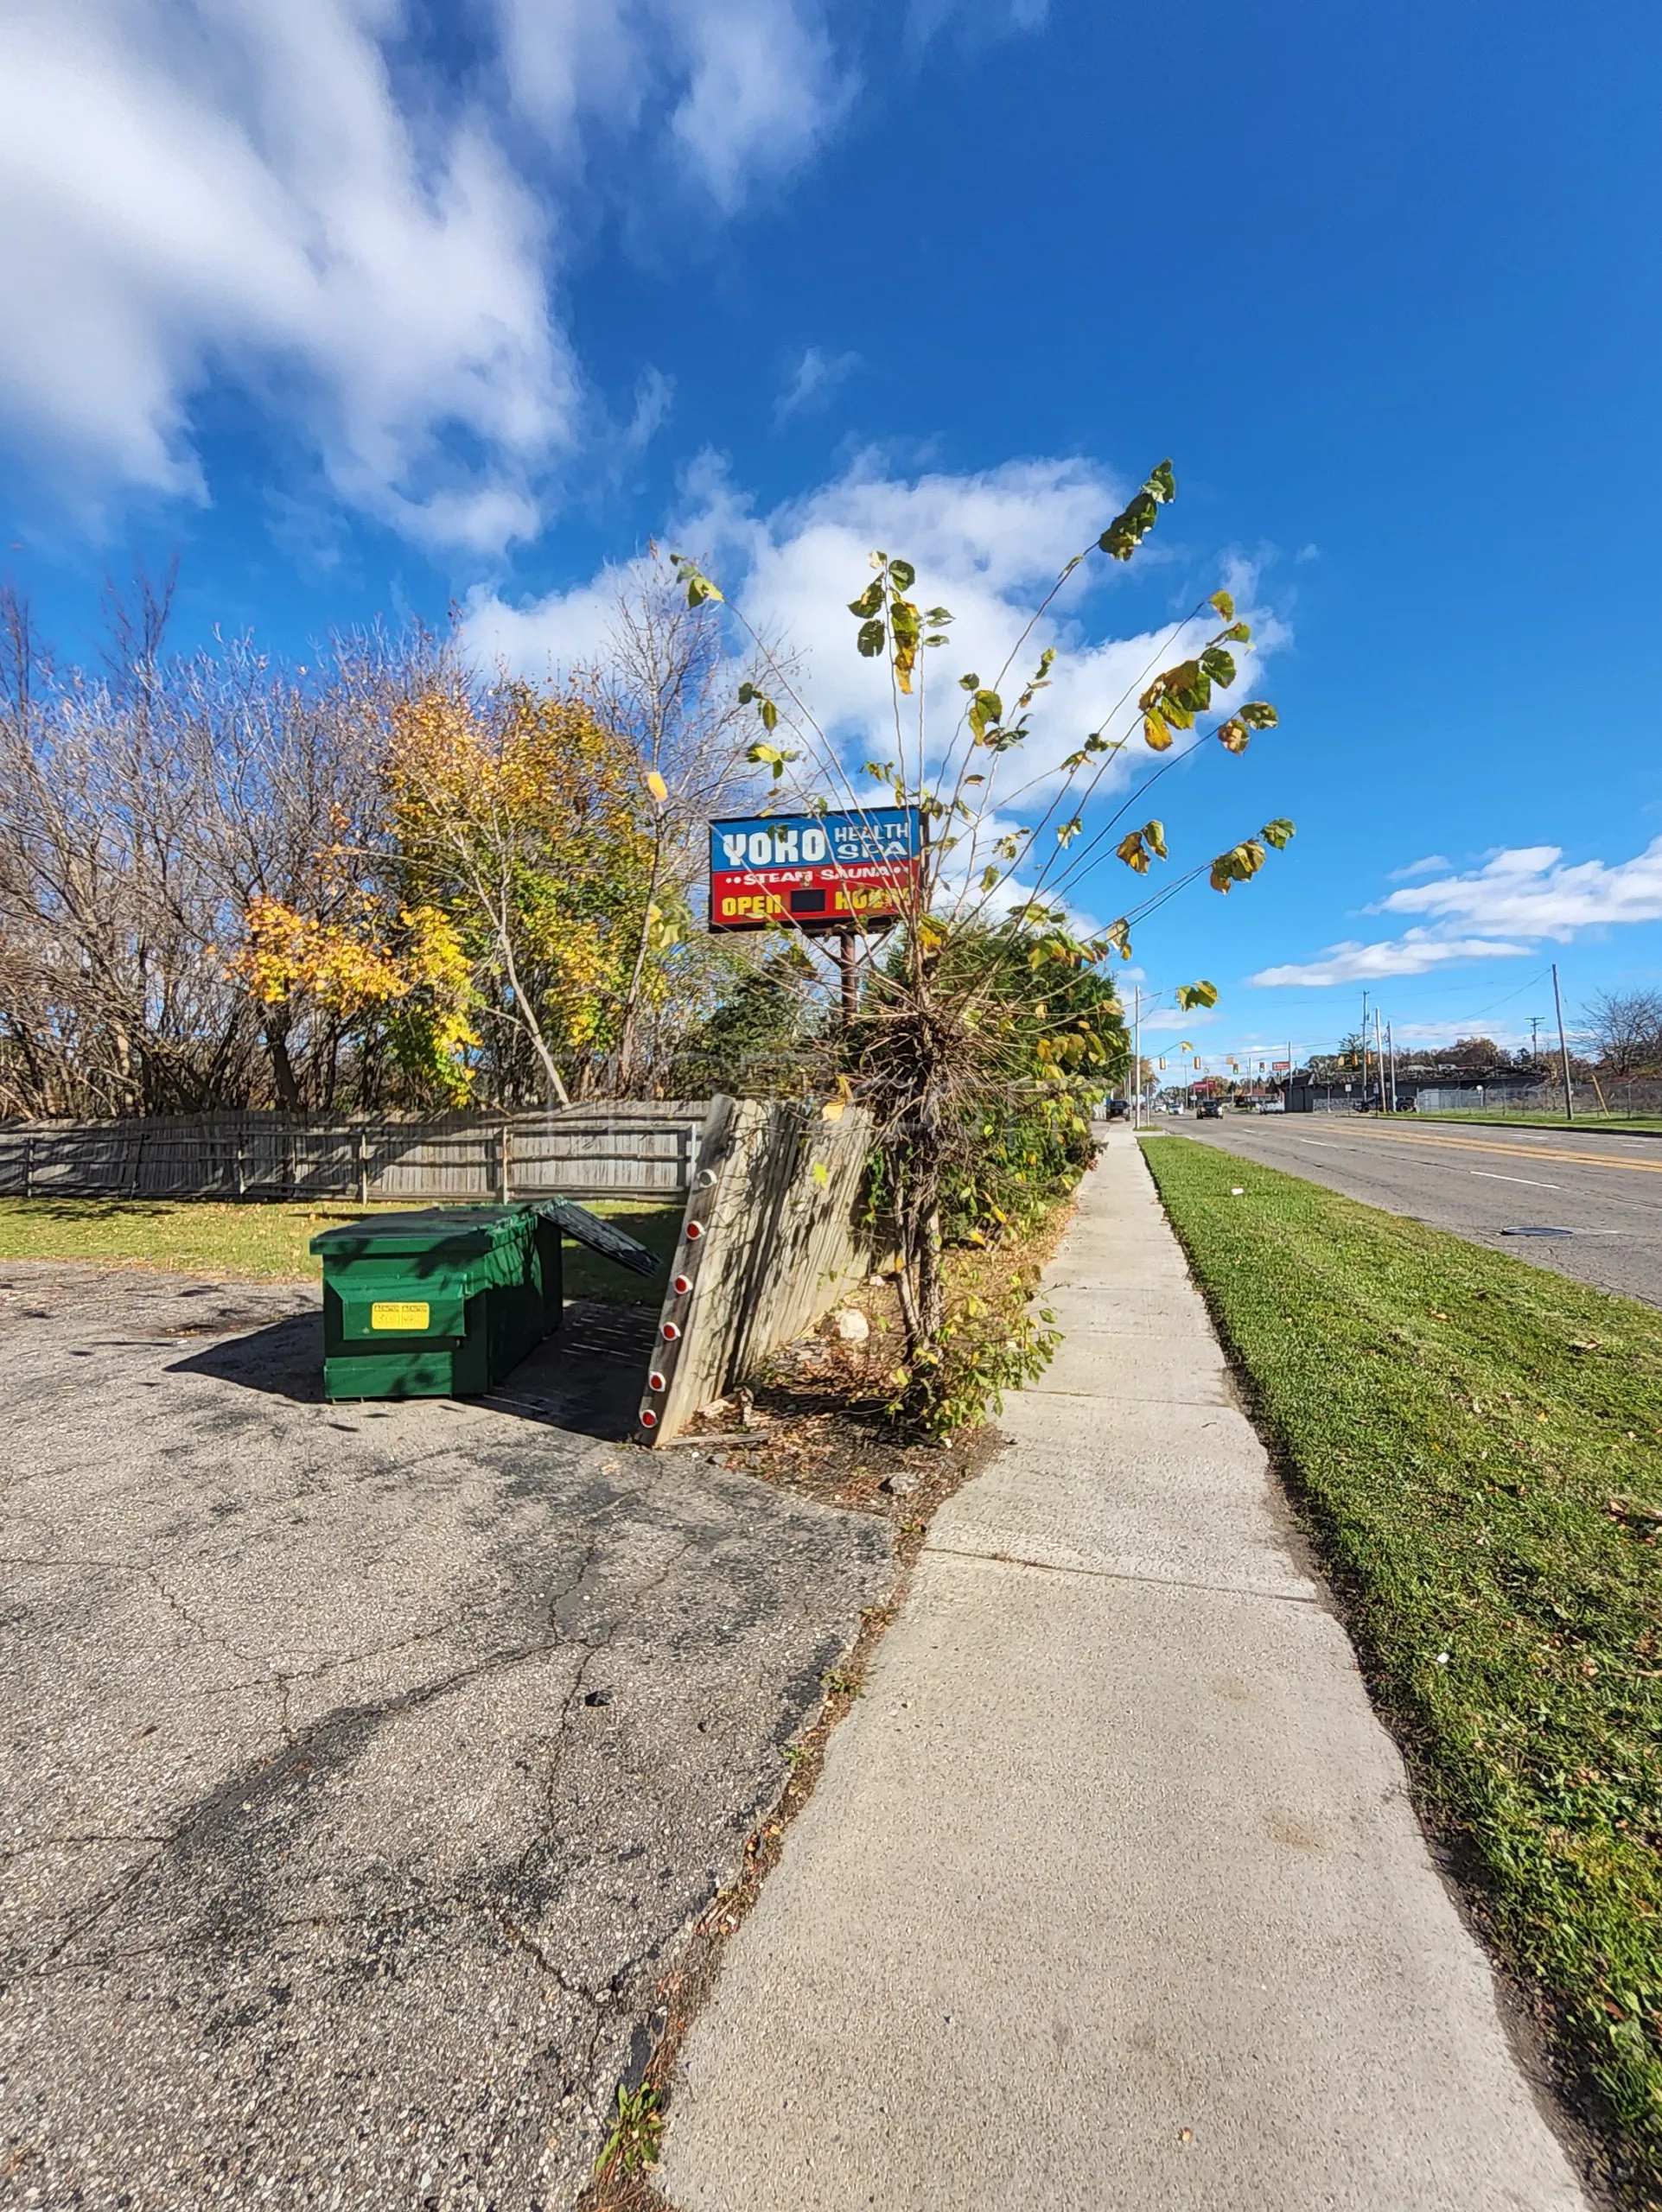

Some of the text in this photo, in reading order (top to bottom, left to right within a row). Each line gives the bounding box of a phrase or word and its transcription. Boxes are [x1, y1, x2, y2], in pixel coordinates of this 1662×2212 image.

[834, 822, 908, 842] HEALTH
[723, 829, 825, 866] YOKO
[837, 841, 908, 860] SPA
[743, 865, 891, 886] STEAM SAUNA
[722, 894, 781, 916] OPEN
